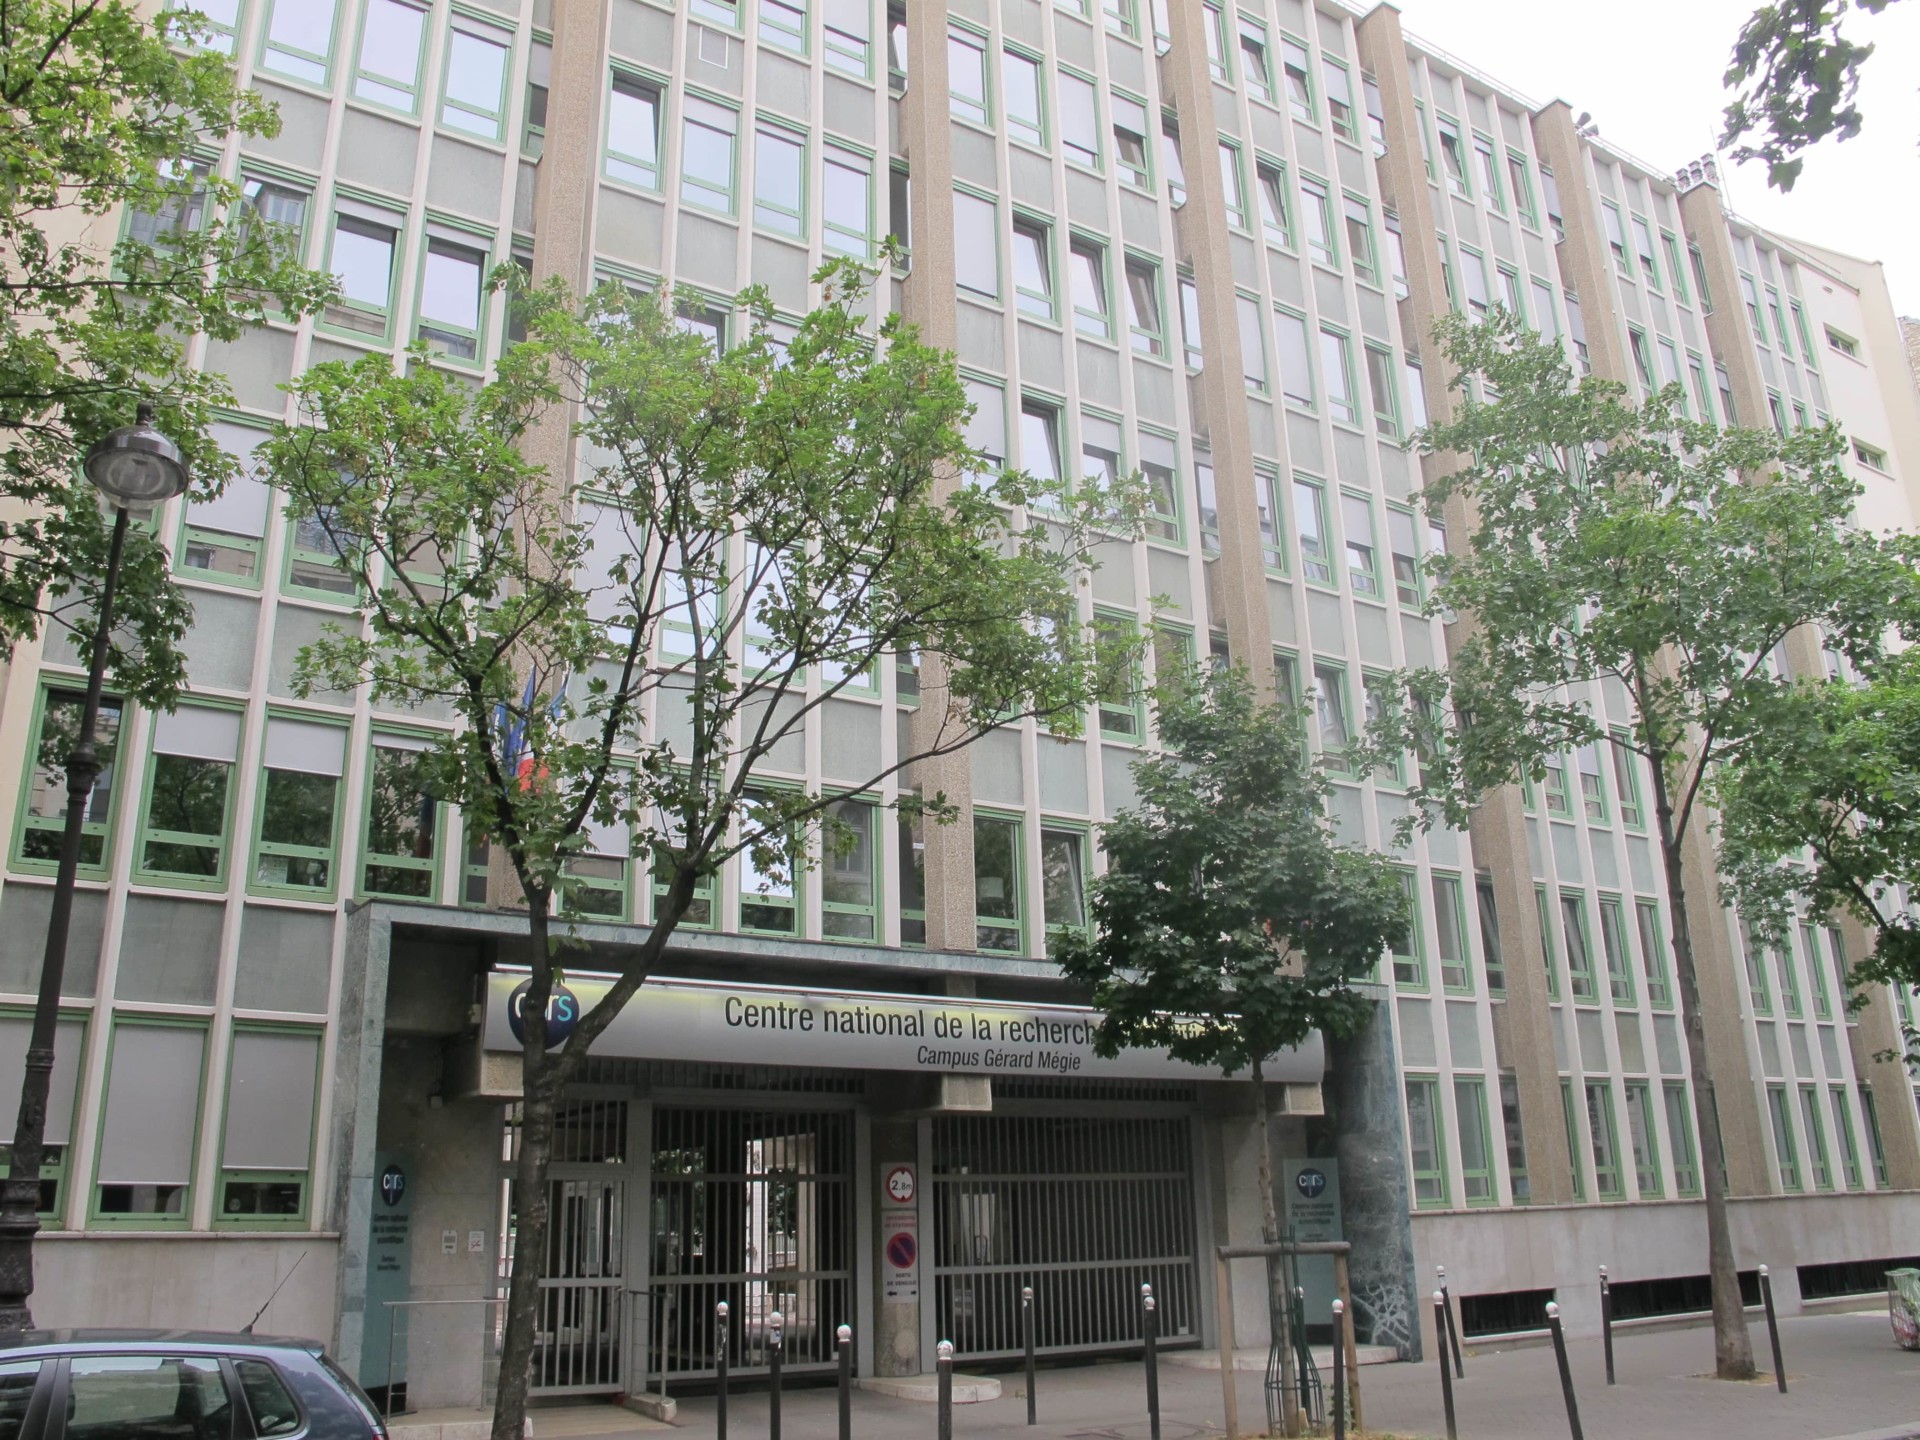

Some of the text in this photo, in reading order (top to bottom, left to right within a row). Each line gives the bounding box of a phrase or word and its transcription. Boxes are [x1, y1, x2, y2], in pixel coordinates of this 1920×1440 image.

[515, 993, 572, 1022] crs
[725, 996, 814, 1032] Centre
[823, 1006, 925, 1037] national
[934, 1011, 963, 1039] de
[971, 1012, 992, 1041] la
[1000, 1016, 1098, 1045] recherch
[917, 1045, 1081, 1073] Campus Gérard Mégie
